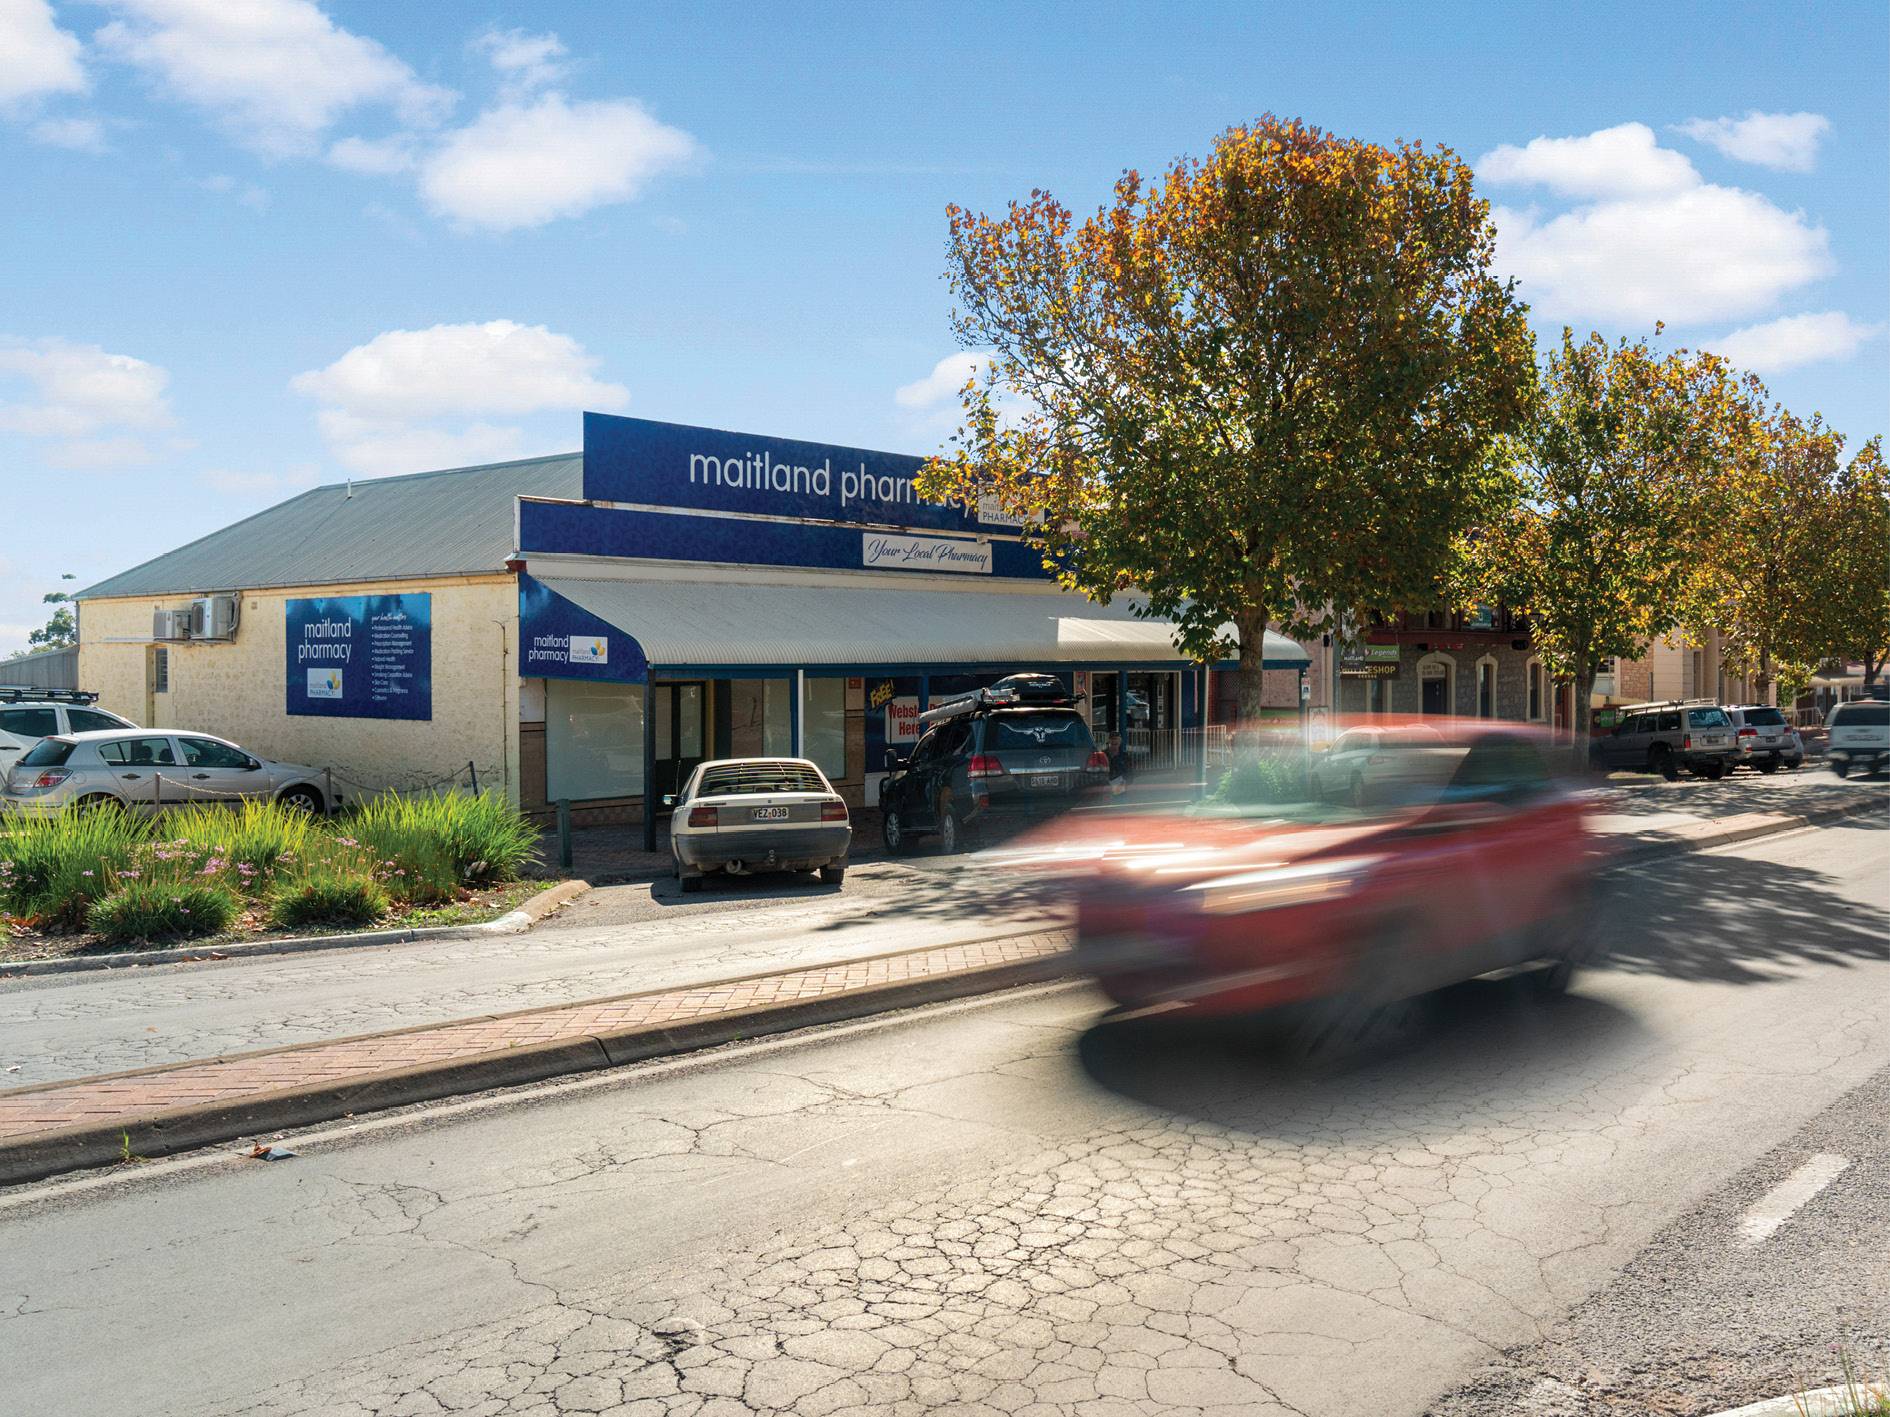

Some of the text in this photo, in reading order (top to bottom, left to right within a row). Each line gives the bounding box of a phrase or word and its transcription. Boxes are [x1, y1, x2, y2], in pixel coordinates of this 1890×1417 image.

[690, 451, 830, 496] maitland
[982, 511, 1025, 525] PHARMAC
[867, 539, 988, 570] Your Local Pharmacy
[304, 617, 352, 638] maitland
[298, 639, 352, 664] pharmacy
[534, 634, 569, 648] maitland
[528, 647, 568, 664] pharmacy
